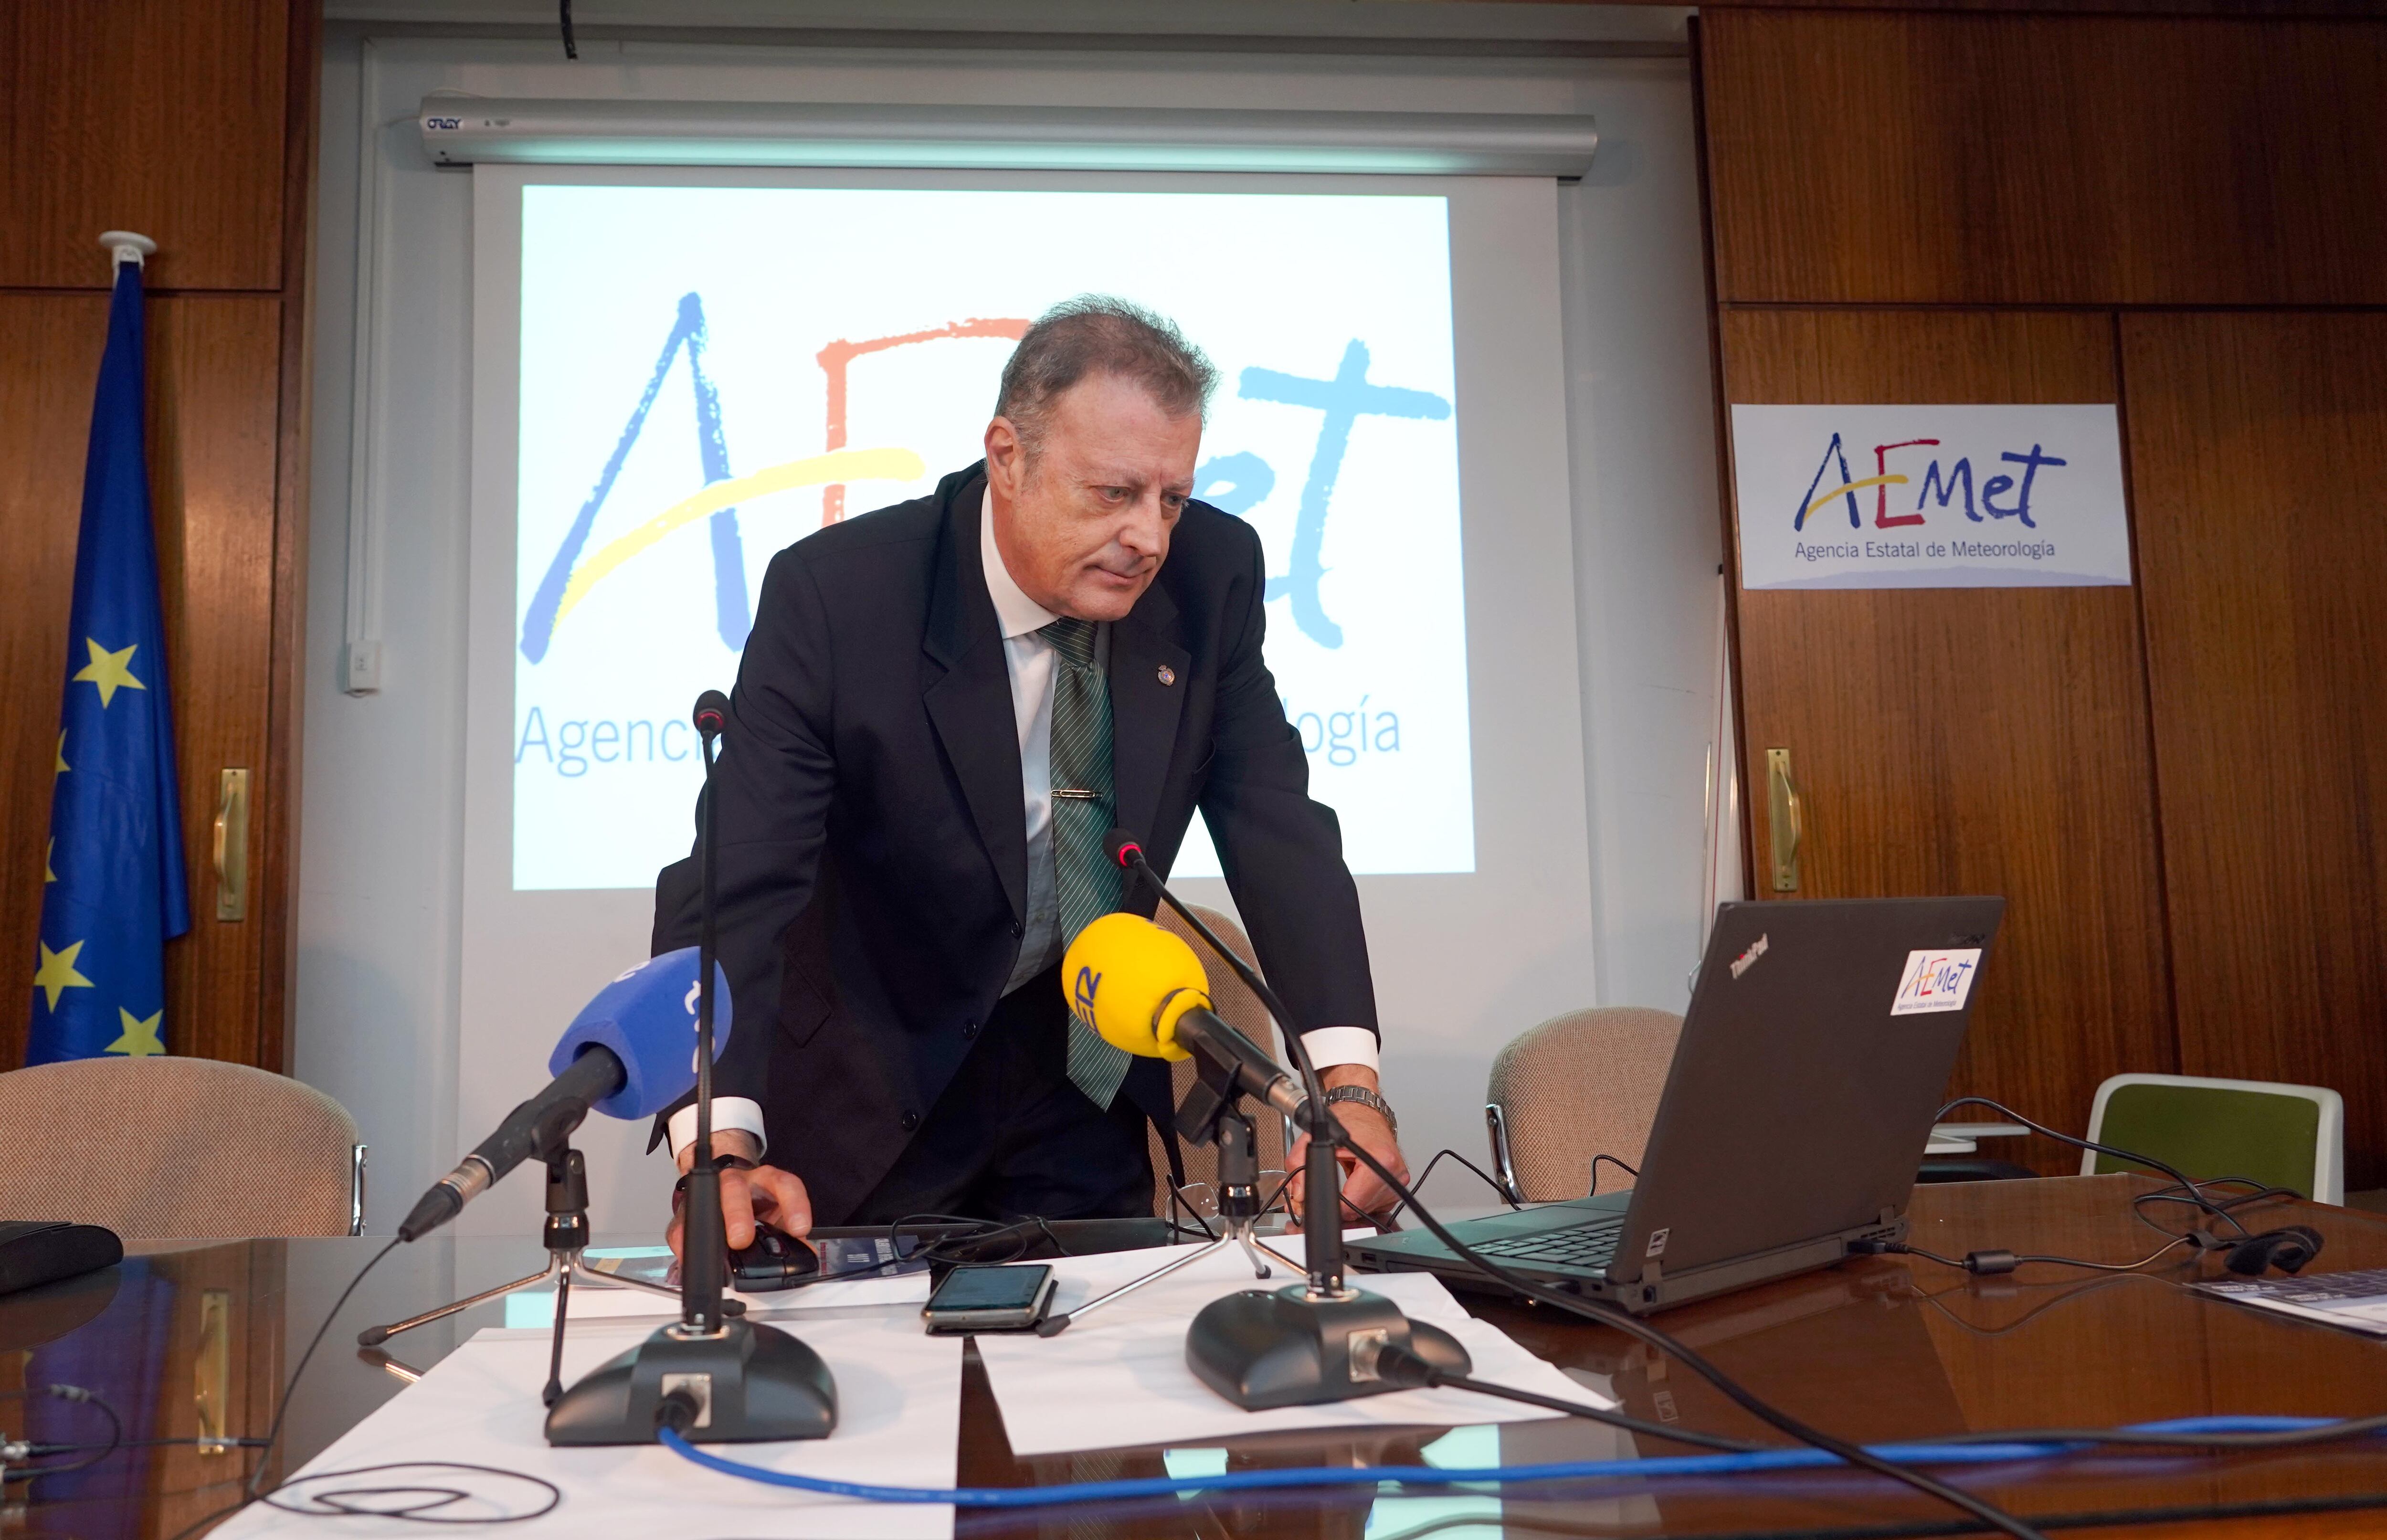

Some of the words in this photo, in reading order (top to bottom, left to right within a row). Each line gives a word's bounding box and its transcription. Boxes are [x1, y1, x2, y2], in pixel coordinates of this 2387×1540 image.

[1794, 432, 2067, 531] AEMet
[1795, 541, 1859, 561] Agencia
[1866, 541, 1920, 558] Estatal
[1926, 541, 1946, 557] de
[1952, 539, 2056, 559] Meteorología
[1901, 956, 1972, 999] AEMet
